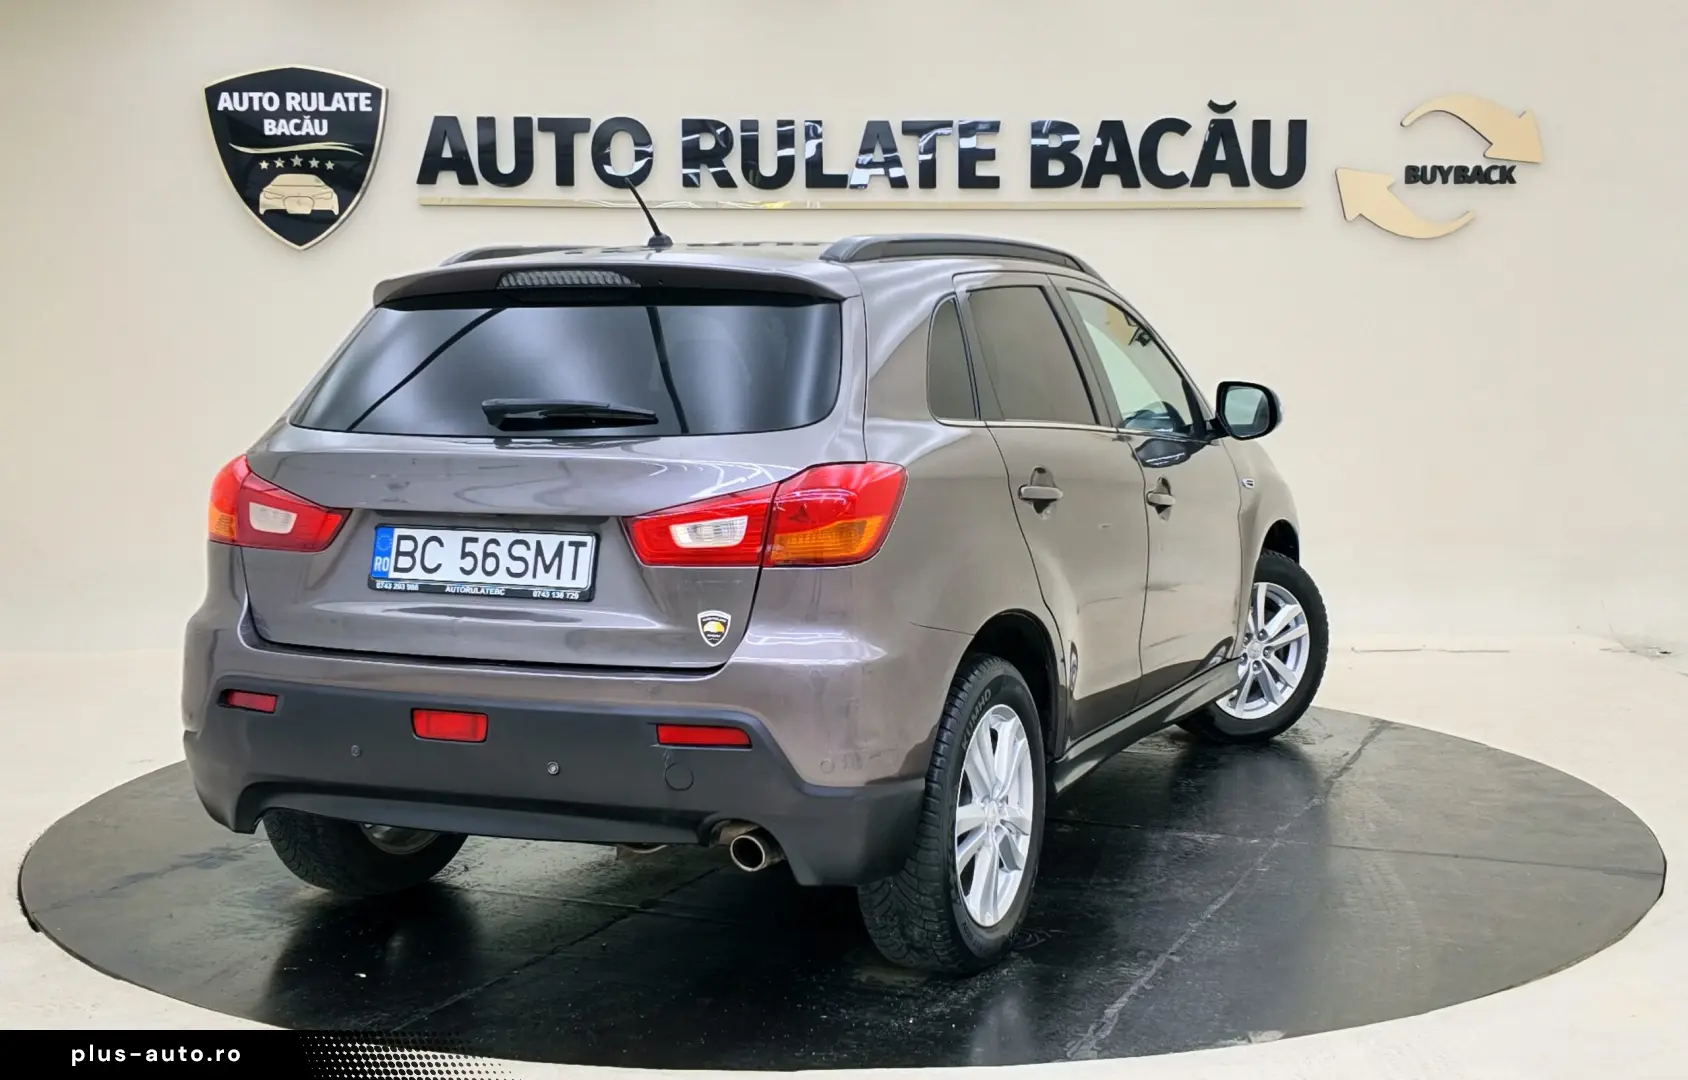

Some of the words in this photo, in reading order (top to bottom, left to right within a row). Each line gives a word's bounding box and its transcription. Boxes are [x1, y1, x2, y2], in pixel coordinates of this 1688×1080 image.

[217, 91, 280, 111] AUTO
[285, 91, 372, 112] RULATE
[263, 115, 328, 136] BACĂU
[416, 115, 653, 189] AUTO
[681, 118, 1001, 190] RULATE
[1030, 99, 1307, 189] BACĂU
[1404, 165, 1517, 185] BUYBACK
[374, 556, 390, 572] RO
[393, 534, 445, 575] BC
[961, 688, 992, 750] KUMHO
